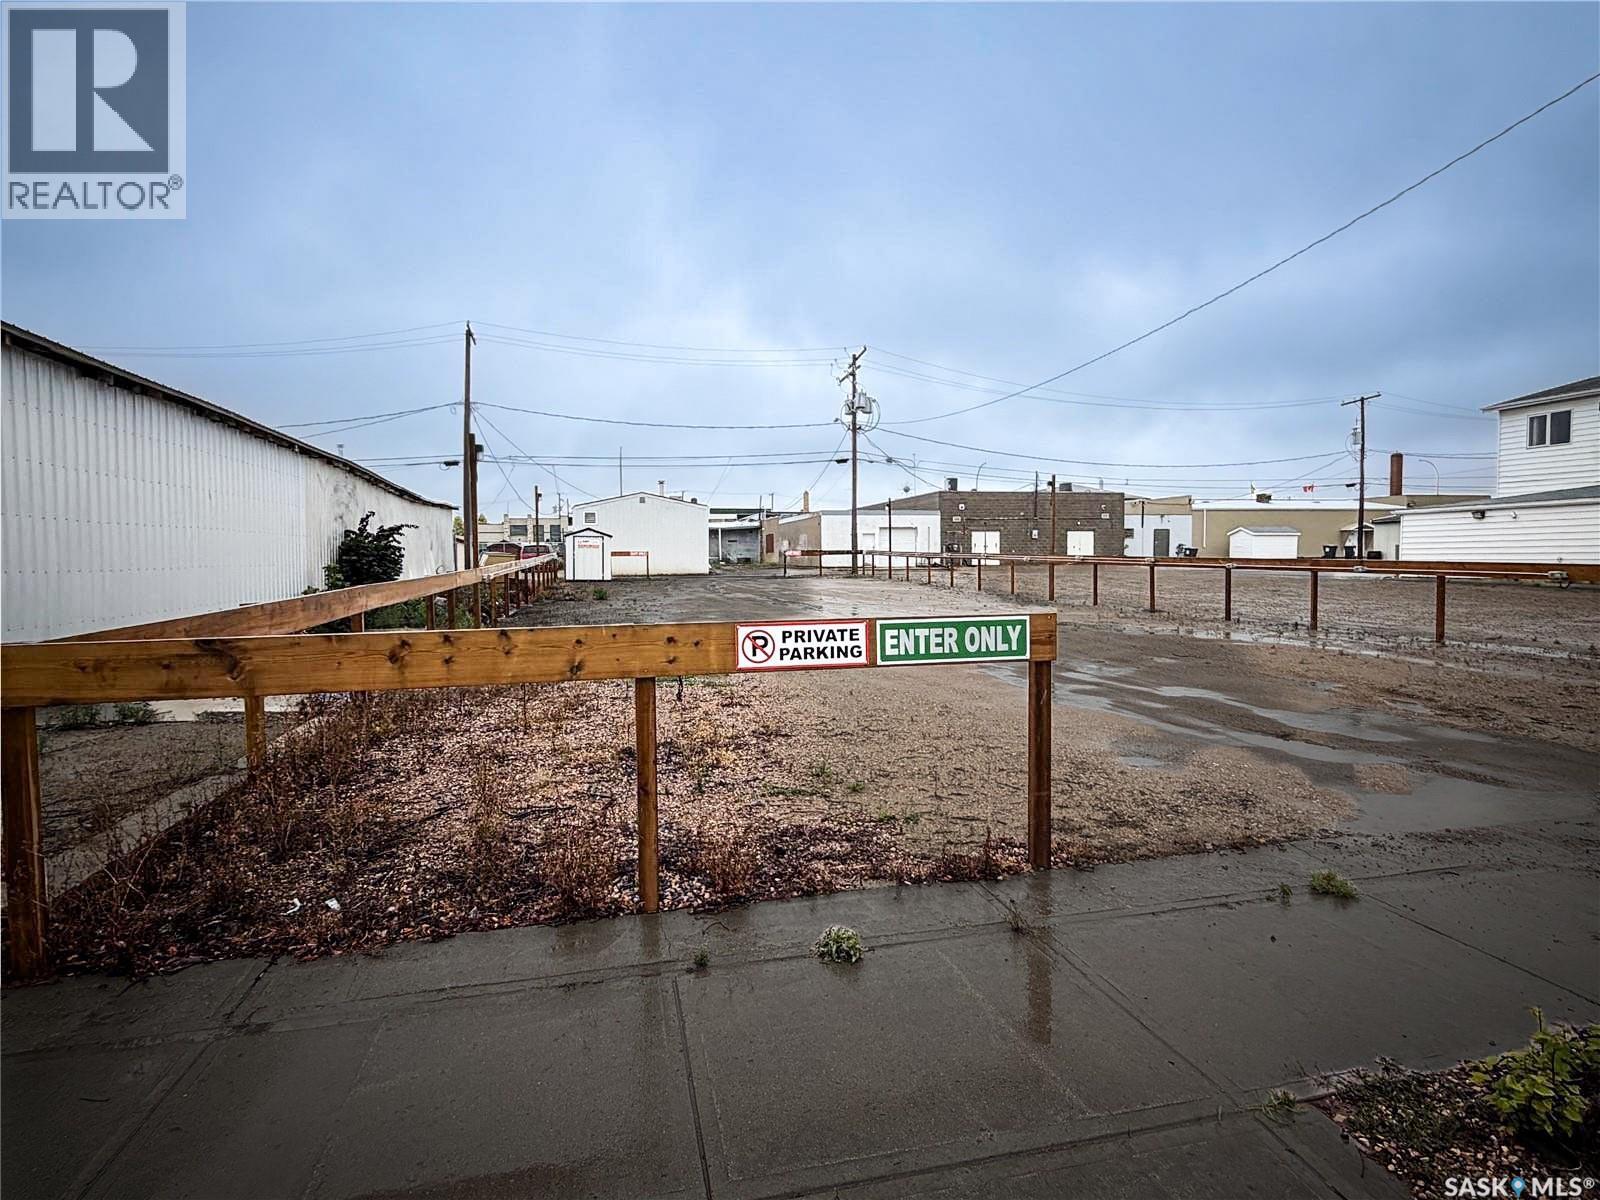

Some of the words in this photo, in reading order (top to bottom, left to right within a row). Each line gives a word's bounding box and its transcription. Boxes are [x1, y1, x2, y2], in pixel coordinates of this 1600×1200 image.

[781, 628, 860, 644] PRIVATE
[884, 627, 959, 656] ENTER
[964, 624, 1022, 653] ONLY
[779, 644, 863, 661] PARKING
